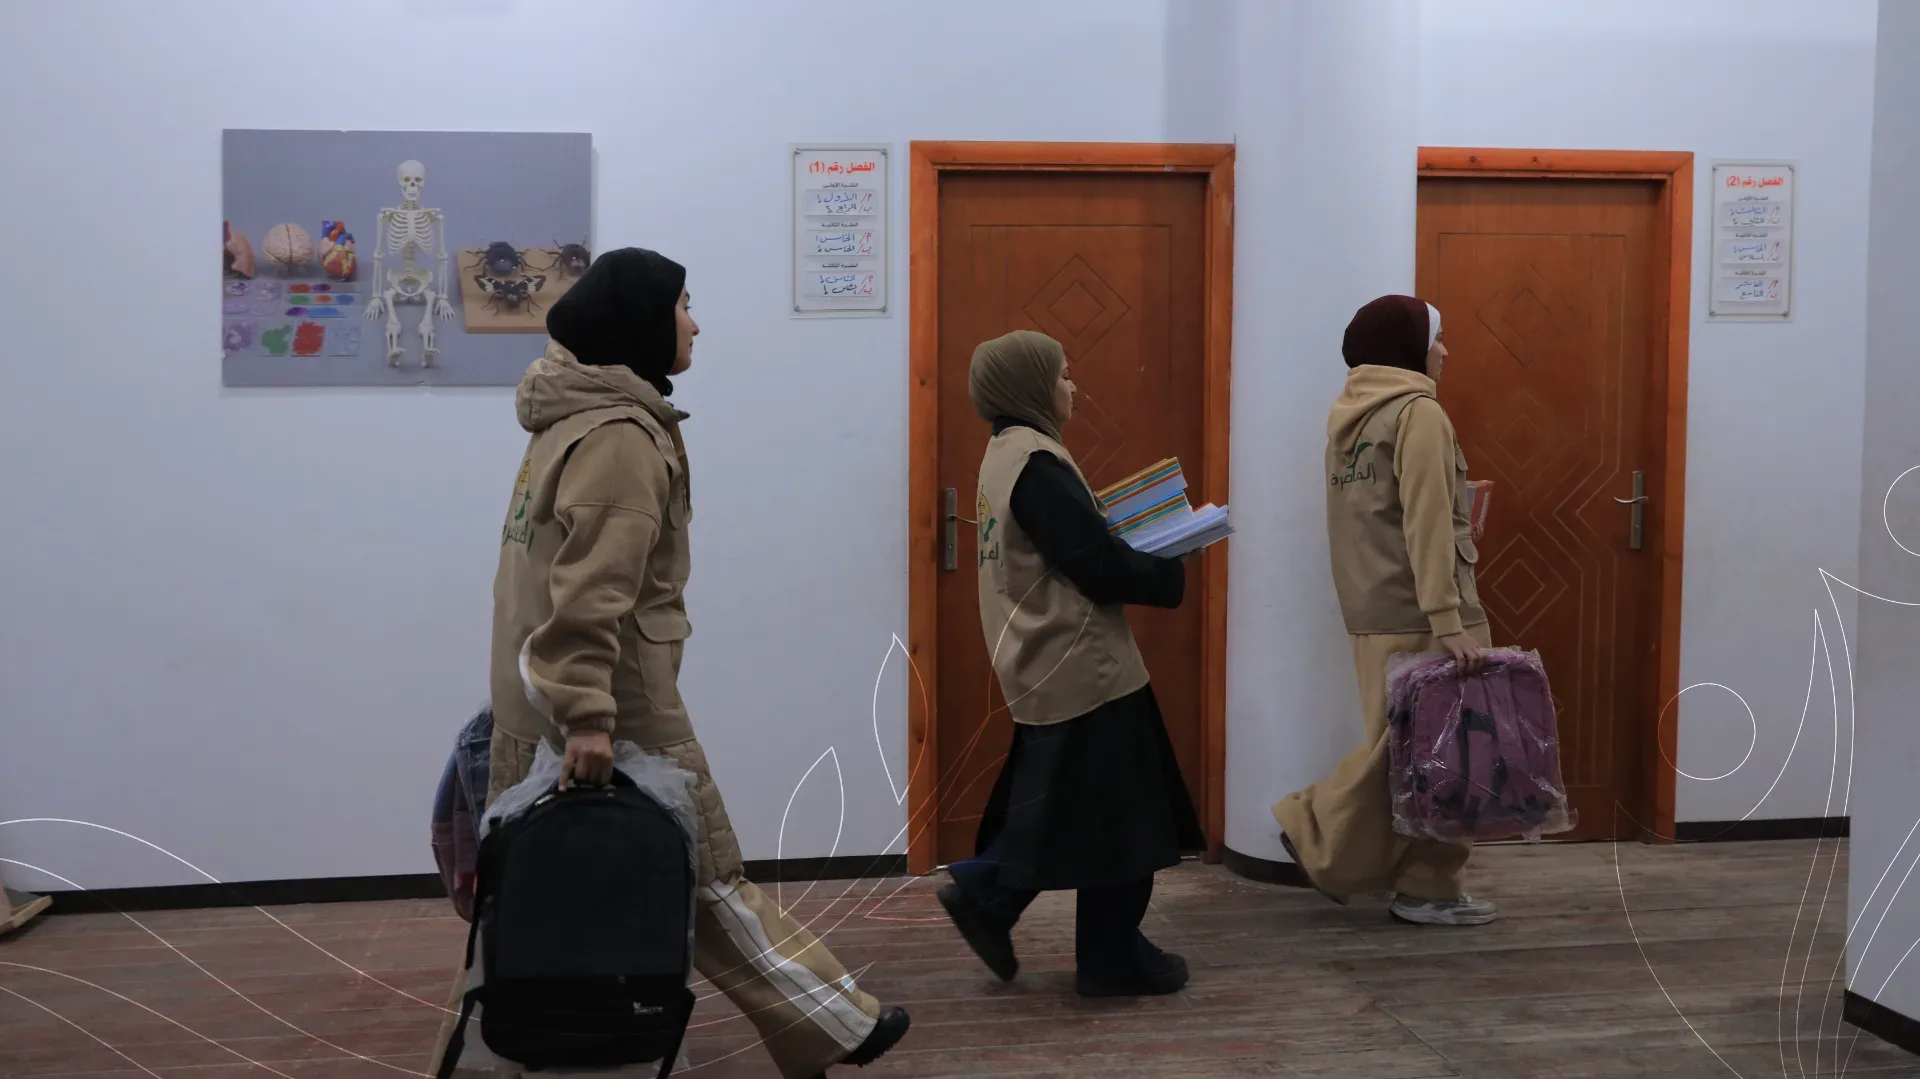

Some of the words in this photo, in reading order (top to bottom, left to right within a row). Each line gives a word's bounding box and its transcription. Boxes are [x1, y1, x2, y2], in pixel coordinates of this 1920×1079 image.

[809, 160, 825, 174] (1)
[828, 161, 844, 175] رقم
[846, 160, 875, 174] الفصل
[1726, 175, 1740, 187] (2)
[1742, 176, 1756, 188] رقم
[1758, 176, 1783, 188] الفصل
